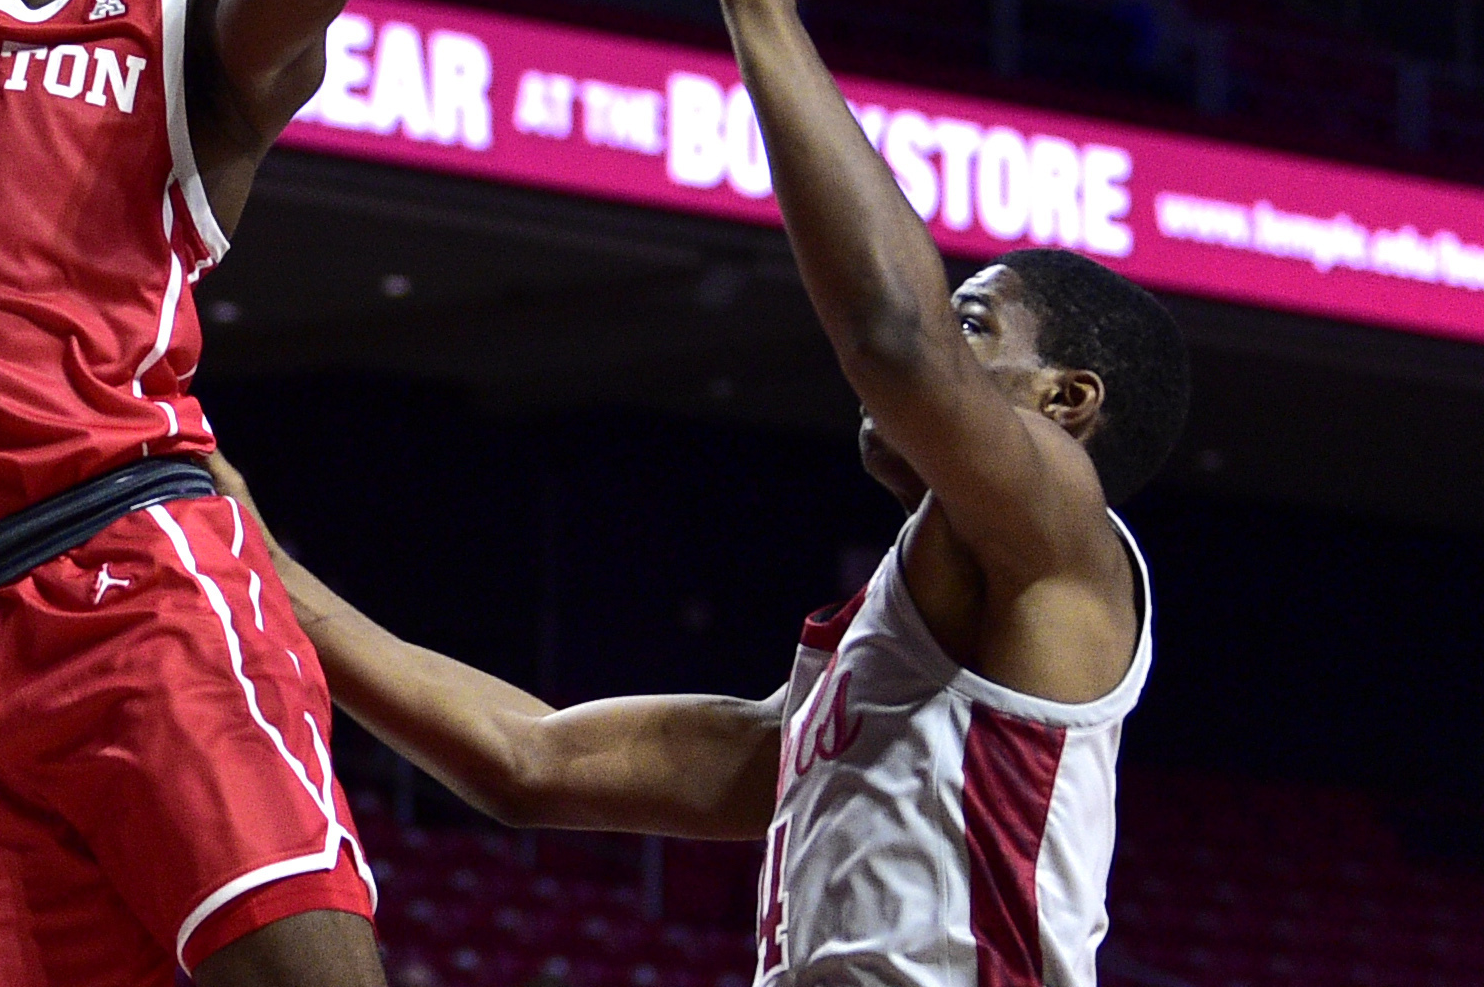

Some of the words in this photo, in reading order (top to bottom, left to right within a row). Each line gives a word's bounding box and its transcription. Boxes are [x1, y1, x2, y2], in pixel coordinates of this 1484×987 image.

[294, 15, 493, 151] EAR
[516, 70, 575, 139] AT
[582, 79, 665, 155] THE
[666, 72, 1134, 258] BOSTORE
